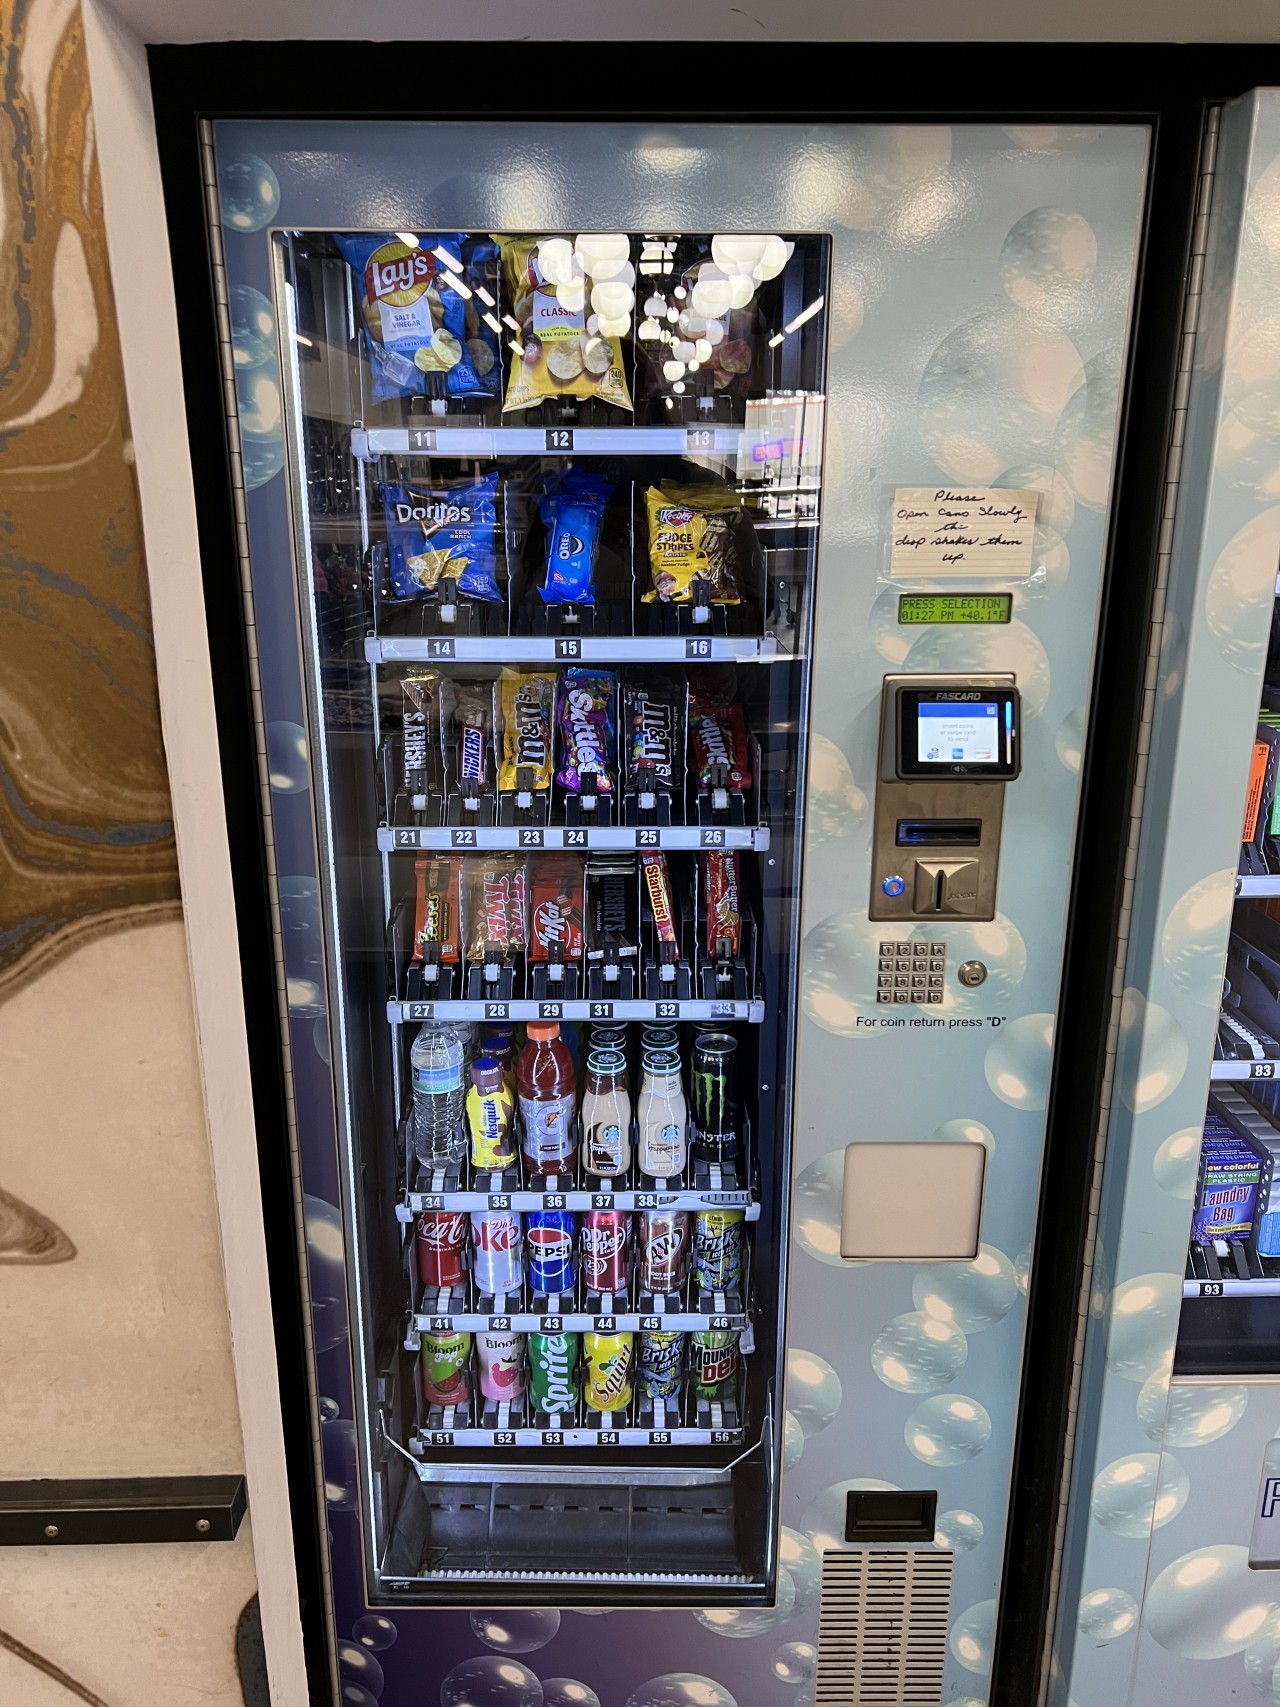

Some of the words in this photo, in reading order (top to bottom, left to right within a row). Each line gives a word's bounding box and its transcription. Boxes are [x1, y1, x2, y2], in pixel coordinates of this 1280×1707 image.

[372, 253, 428, 297] Lay's
[395, 314, 410, 322] SALT
[392, 320, 421, 328] VINEGAR
[610, 370, 622, 378] 240
[414, 434, 430, 446] 11
[551, 432, 569, 446] 12
[692, 431, 710, 446] 13
[934, 490, 986, 502] Please
[396, 503, 472, 526] Doritos
[662, 510, 694, 523] Keebler
[897, 509, 929, 520] Open
[978, 506, 1028, 523] Slowly
[658, 533, 692, 543] FUDGE
[895, 535, 925, 548] drop
[930, 535, 979, 545] shakes
[980, 534, 1022, 546] them
[560, 532, 571, 560] OREO
[942, 553, 965, 564] up.
[903, 599, 936, 609] PRESS
[942, 599, 1000, 609] SELECTION
[902, 610, 935, 621] 01:27
[940, 610, 954, 620] PM
[434, 642, 451, 655] 14
[560, 641, 577, 655] 15
[691, 641, 708, 654] 16
[935, 692, 982, 701] FASCARD
[568, 689, 598, 773] Skittles
[463, 728, 482, 779] NICKERS
[401, 832, 416, 843] 21
[456, 832, 473, 843] 22
[523, 832, 540, 843] 23
[568, 832, 584, 843] 24
[640, 832, 657, 843] 25
[705, 832, 722, 843] 26
[645, 864, 669, 923] Starburst
[603, 877, 626, 932] HERSHEY'S
[414, 1005, 431, 1017] 27
[489, 1004, 506, 1016] 28
[543, 1004, 559, 1016] 29
[594, 1004, 609, 1015] 31
[660, 1004, 676, 1015] 32
[715, 1003, 731, 1014] 33
[856, 1017, 878, 1027] For
[880, 1017, 906, 1027] coin
[909, 1017, 945, 1027] return
[949, 1019, 983, 1029] press
[986, 1017, 1007, 1027] "D"
[1255, 1064, 1271, 1076] 83
[485, 1100, 500, 1138] Nesquik
[696, 1130, 737, 1142] NSTER
[1223, 1162, 1259, 1171] colorful
[426, 1197, 441, 1207] 34
[493, 1196, 508, 1207] 35
[547, 1196, 563, 1207] 36
[596, 1195, 610, 1206] 37
[638, 1195, 653, 1206] 38
[1203, 1186, 1250, 1207] Laundry
[1213, 1206, 1234, 1222] Bag
[472, 1222, 521, 1253] oke
[591, 1227, 610, 1240] Dr
[582, 1228, 623, 1254] Pepper
[529, 1241, 569, 1258] PEPSI
[1204, 1284, 1220, 1295] 93
[435, 1318, 449, 1328] 41
[492, 1318, 508, 1328] 42
[544, 1318, 560, 1328] 43
[598, 1318, 613, 1328] 44
[643, 1318, 658, 1328] 45
[713, 1318, 728, 1328] 46
[426, 1341, 465, 1354] Bloom
[484, 1334, 523, 1350] Bloom
[691, 1343, 736, 1370] MOUNT
[540, 1334, 573, 1413] Sprite
[594, 1344, 632, 1403] Squirt
[436, 1433, 450, 1443] 51
[498, 1433, 512, 1443] 52
[545, 1433, 561, 1443] 53
[601, 1433, 616, 1443] 54
[653, 1433, 668, 1443] 55
[715, 1433, 729, 1443] 56
